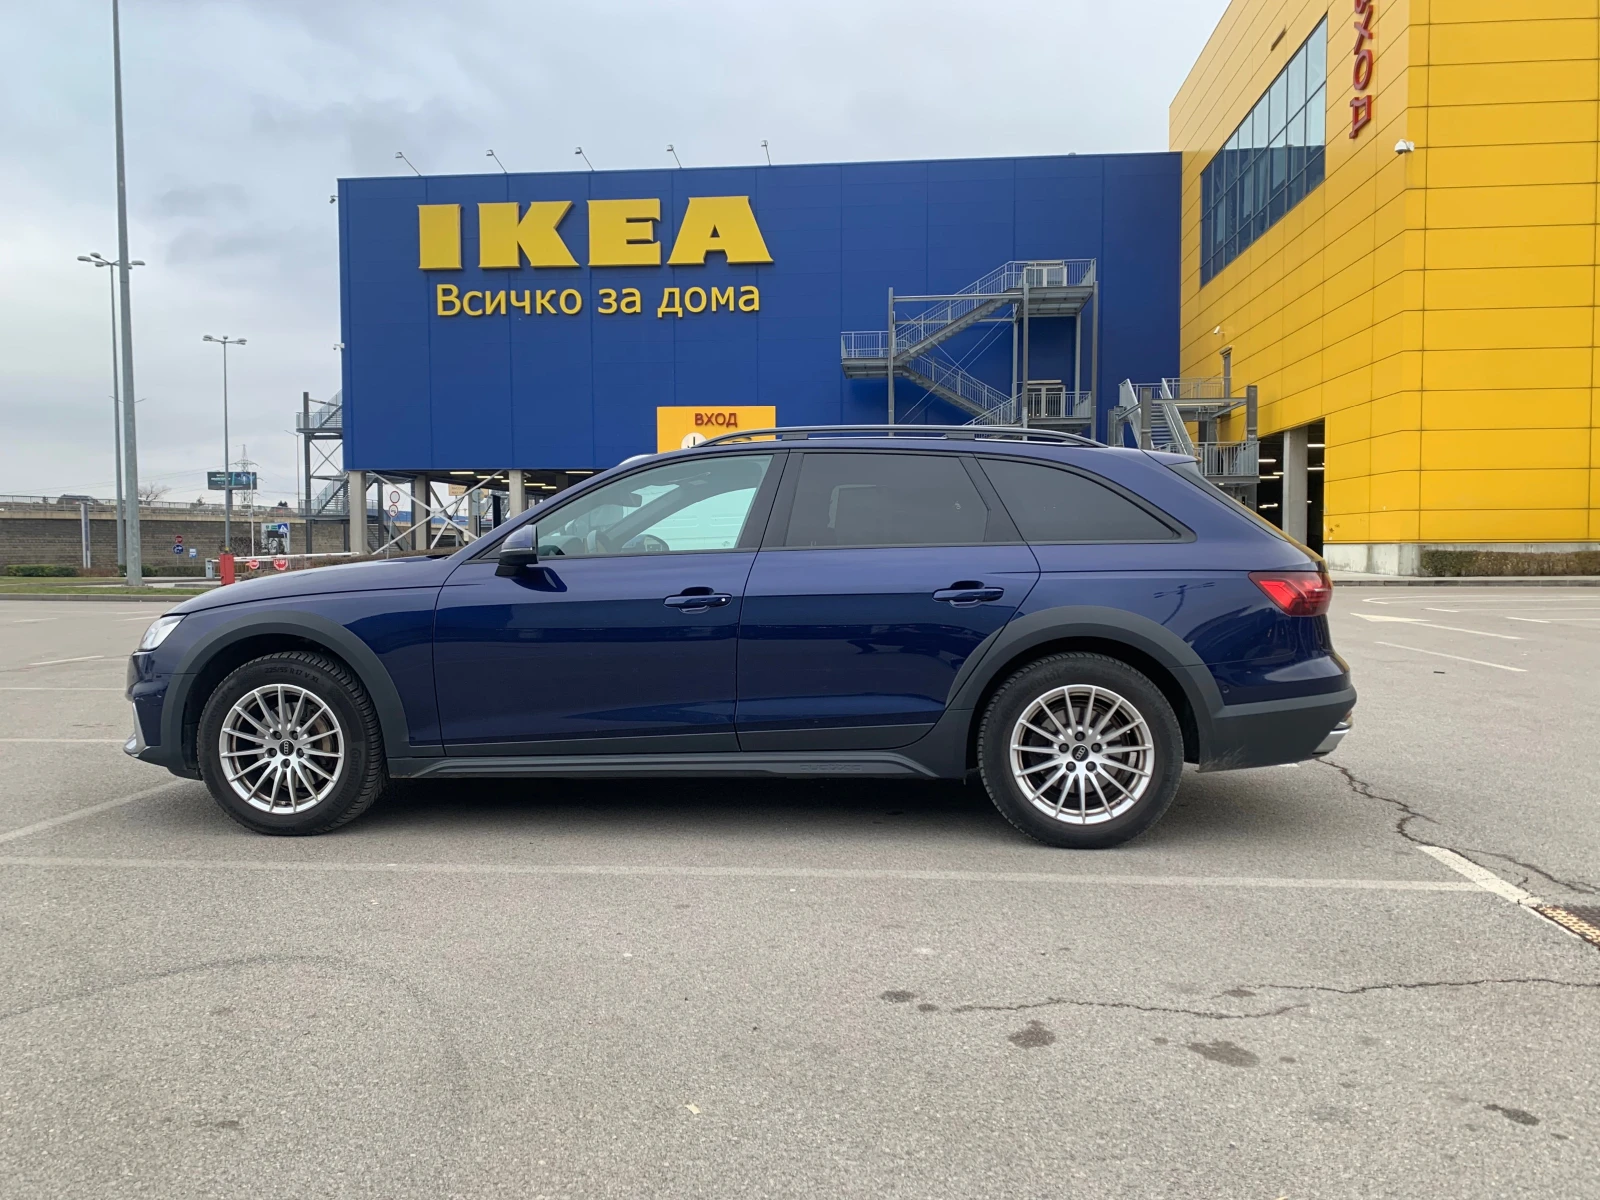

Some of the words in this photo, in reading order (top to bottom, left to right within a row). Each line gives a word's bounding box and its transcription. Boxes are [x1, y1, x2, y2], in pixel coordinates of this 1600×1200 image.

[417, 195, 774, 270] IKEA
[436, 284, 583, 316] Всичко
[598, 287, 642, 314] за
[657, 285, 761, 318] дома
[694, 412, 738, 428] ВХОД
